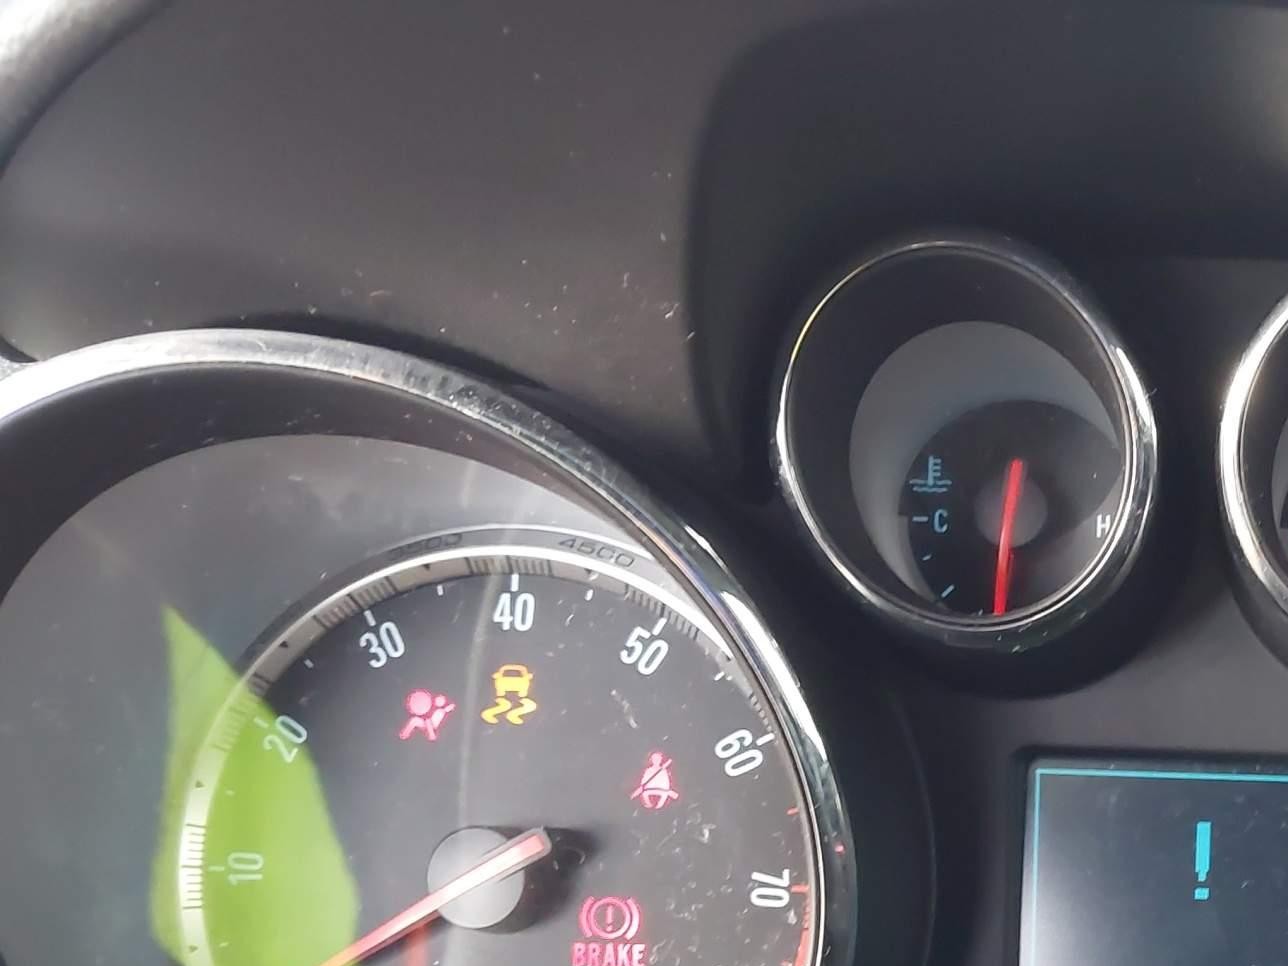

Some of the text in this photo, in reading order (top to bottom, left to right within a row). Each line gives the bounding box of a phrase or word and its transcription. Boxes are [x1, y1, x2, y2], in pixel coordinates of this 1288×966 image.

[933, 508, 948, 533] C
[1096, 513, 1111, 538] H
[493, 592, 535, 632] 40
[360, 621, 405, 669] 30
[619, 626, 669, 675] 50
[263, 715, 308, 764] 20
[714, 728, 763, 776] 60
[228, 852, 264, 885] 10
[750, 868, 790, 908] 70
